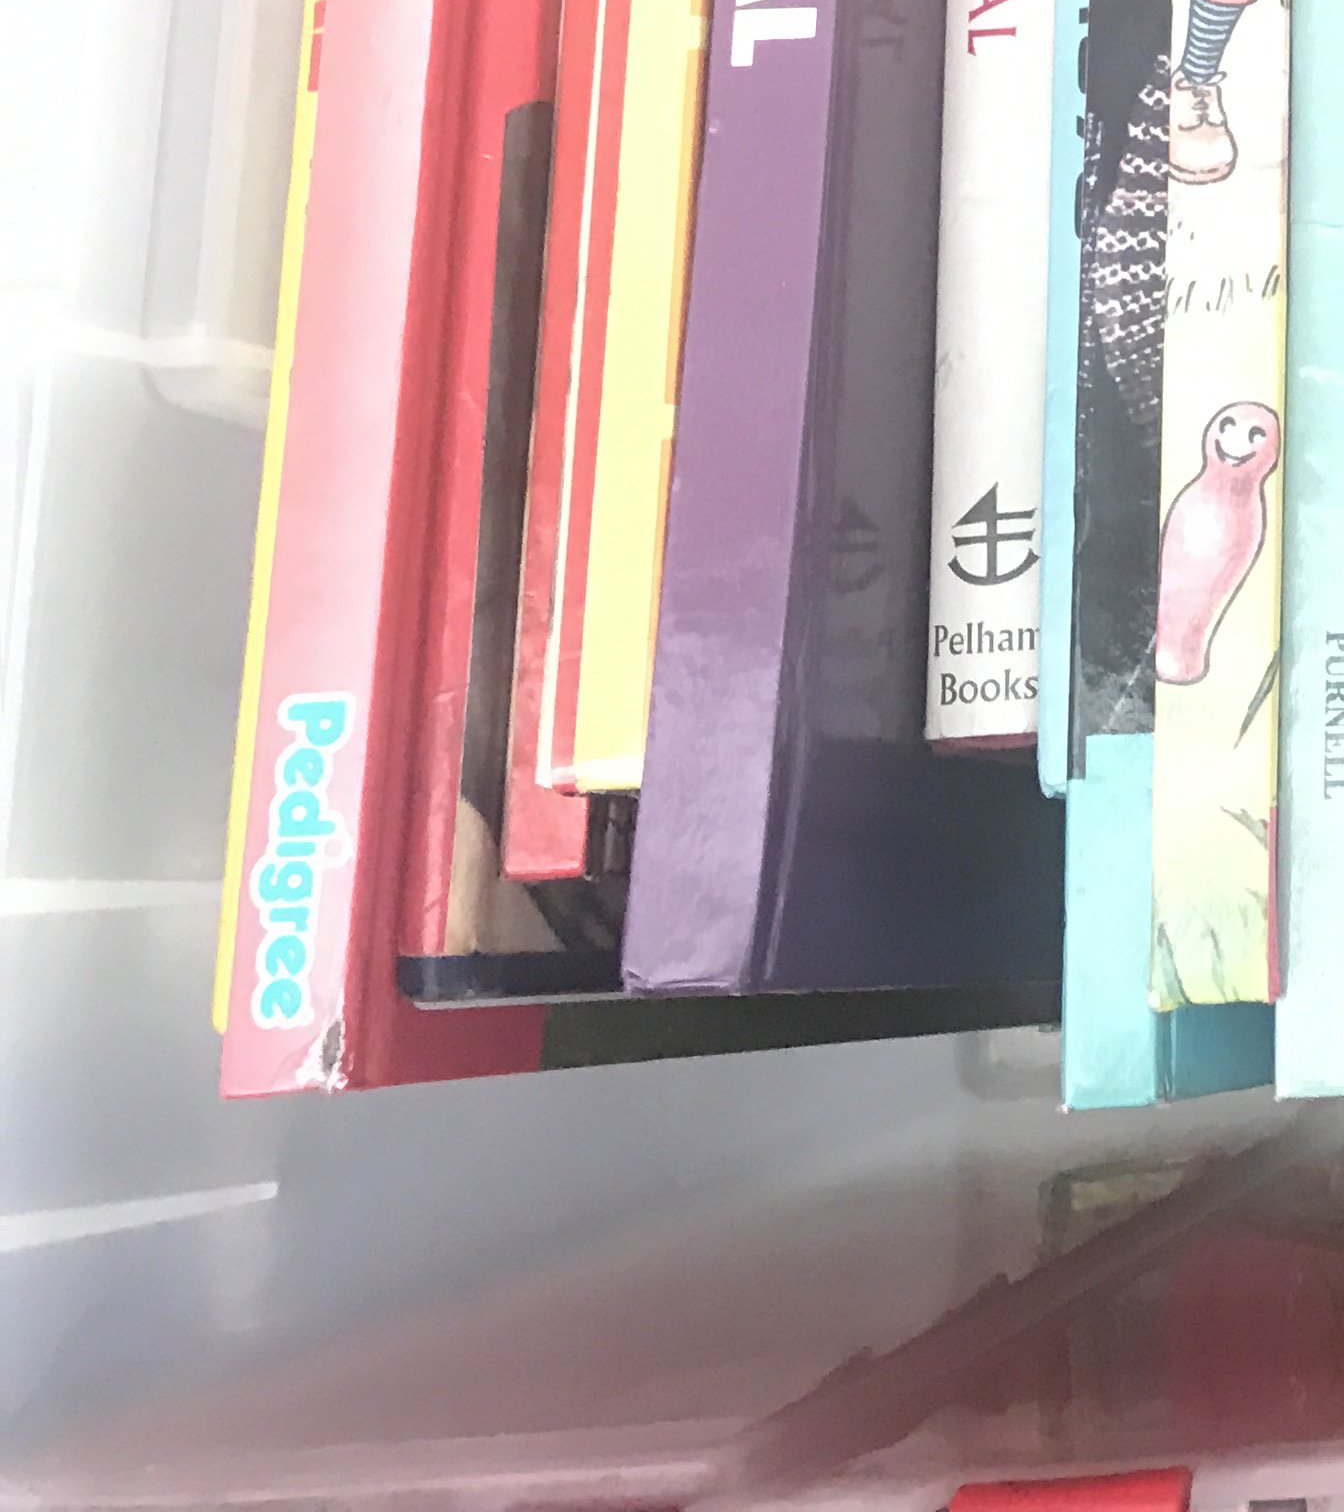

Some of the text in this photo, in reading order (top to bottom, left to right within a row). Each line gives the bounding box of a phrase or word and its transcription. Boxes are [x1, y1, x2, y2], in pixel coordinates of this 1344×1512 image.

[933, 620, 1041, 658] Pelham
[939, 668, 1039, 706] Books
[252, 695, 350, 1024] Pedigree
